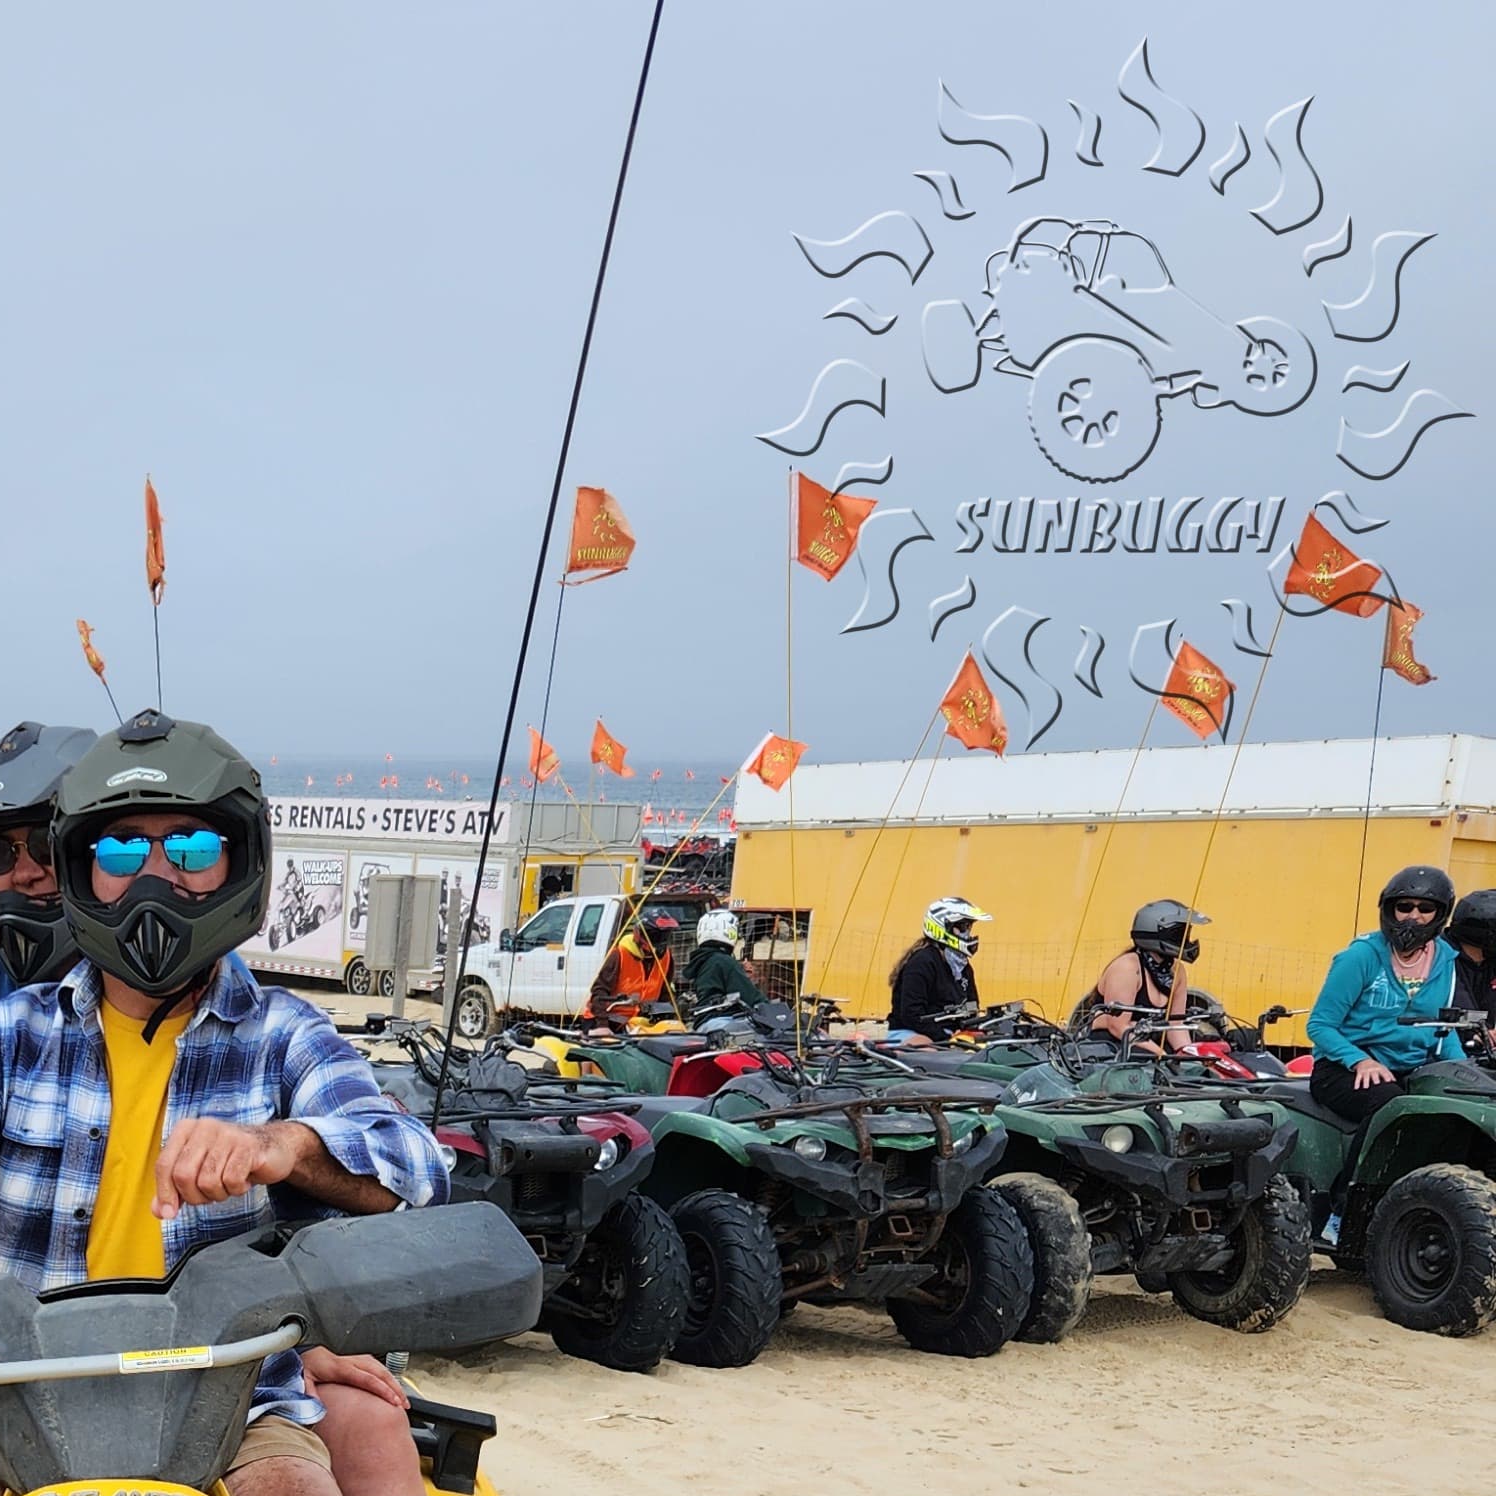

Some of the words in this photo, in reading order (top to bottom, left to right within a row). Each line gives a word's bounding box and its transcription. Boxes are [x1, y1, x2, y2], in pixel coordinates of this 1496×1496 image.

[289, 805, 366, 830] RENTALS
[381, 807, 455, 834] STEVE'S
[461, 810, 505, 835] ATV
[303, 872, 342, 885] WELCOME
